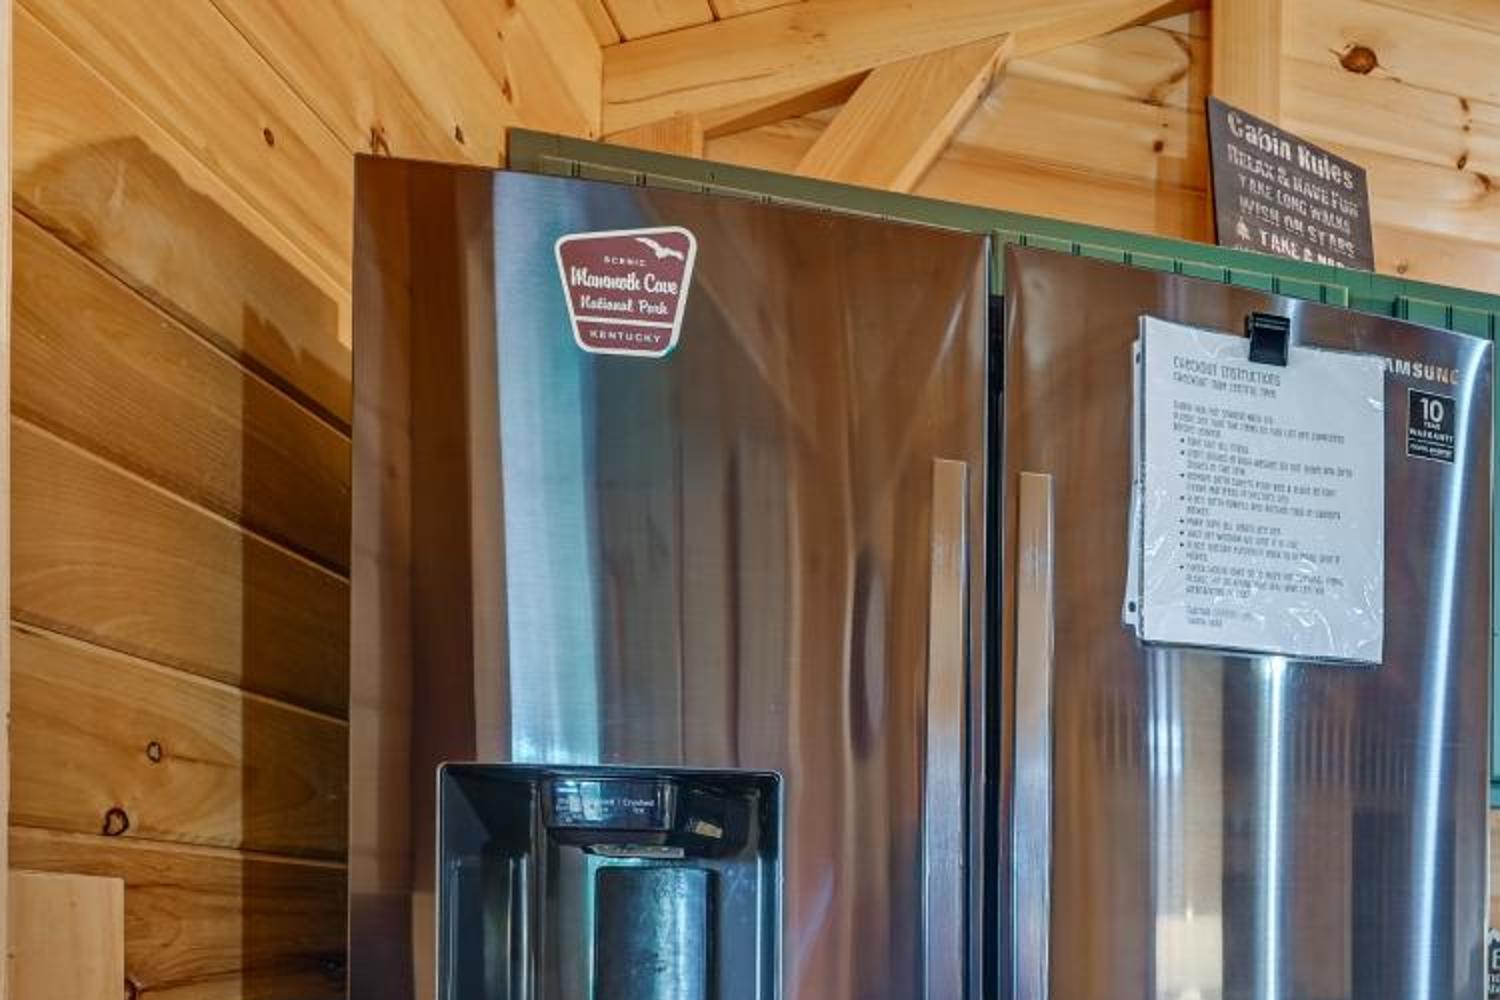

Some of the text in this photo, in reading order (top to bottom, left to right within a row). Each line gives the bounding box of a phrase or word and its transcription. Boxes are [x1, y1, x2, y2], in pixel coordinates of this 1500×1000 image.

[1226, 111, 1354, 190] Cabin Rules
[1226, 143, 1275, 182] RELAX
[1292, 175, 1330, 206] HAVE
[1331, 189, 1360, 219] FUN
[1239, 174, 1351, 235] TAKE LONG WALKS
[1238, 195, 1356, 259] WISH ON STARS
[1259, 229, 1301, 261] TAKE
[570, 265, 679, 296] Mammoth Cave
[580, 294, 669, 315] National Park
[589, 329, 662, 344] KENTUCKY
[1386, 357, 1460, 385] AMSUNG
[1419, 397, 1444, 422] 10
